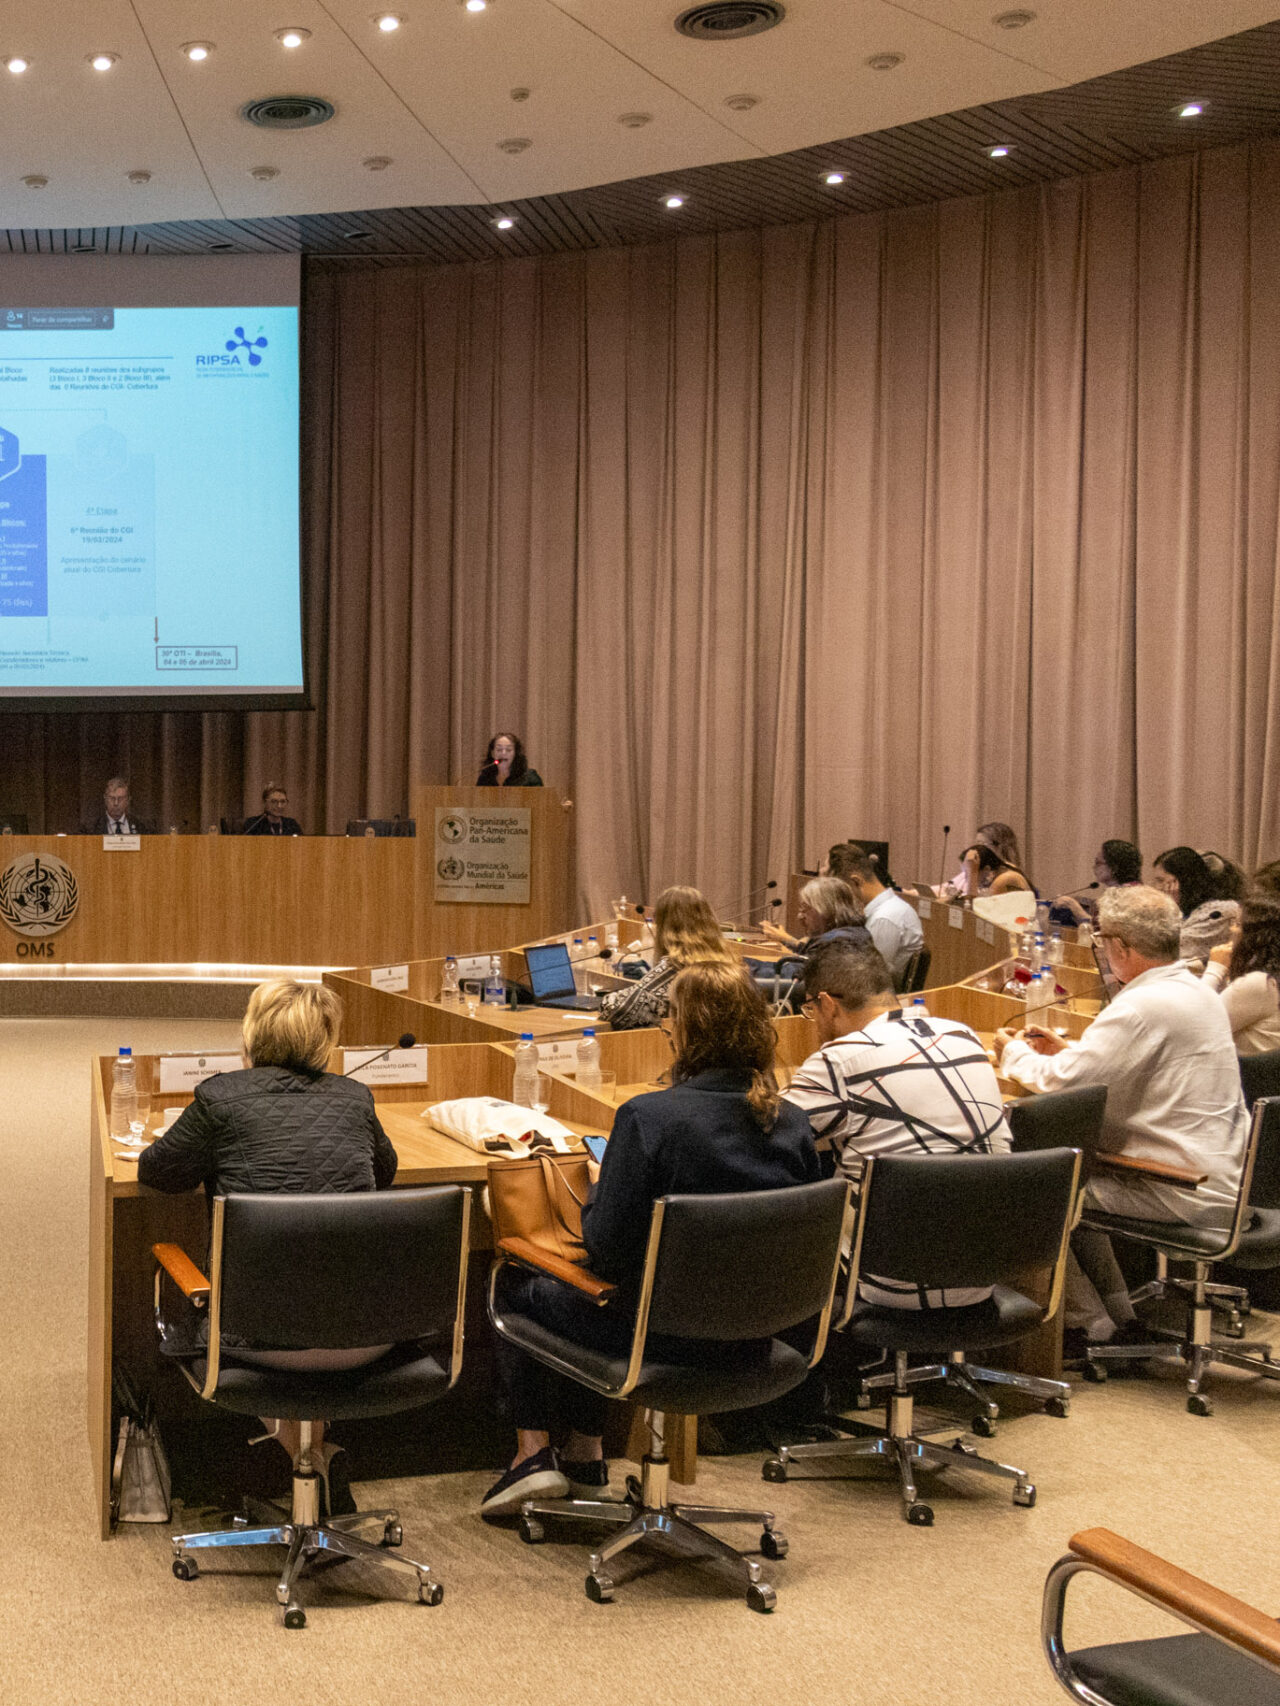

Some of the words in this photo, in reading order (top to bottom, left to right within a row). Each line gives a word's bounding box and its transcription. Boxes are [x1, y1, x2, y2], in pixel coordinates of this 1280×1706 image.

[196, 355, 240, 365] RIPSA
[470, 817, 519, 828] Organização
[470, 827, 528, 835] Pan-Americana
[470, 836, 479, 844] da
[481, 836, 506, 844] Saúde
[467, 861, 509, 870] Organização
[467, 871, 495, 880] Mundial
[497, 871, 505, 880] da
[507, 871, 528, 880] Saúde
[475, 882, 504, 890] Américas
[16, 943, 55, 958] OMS
